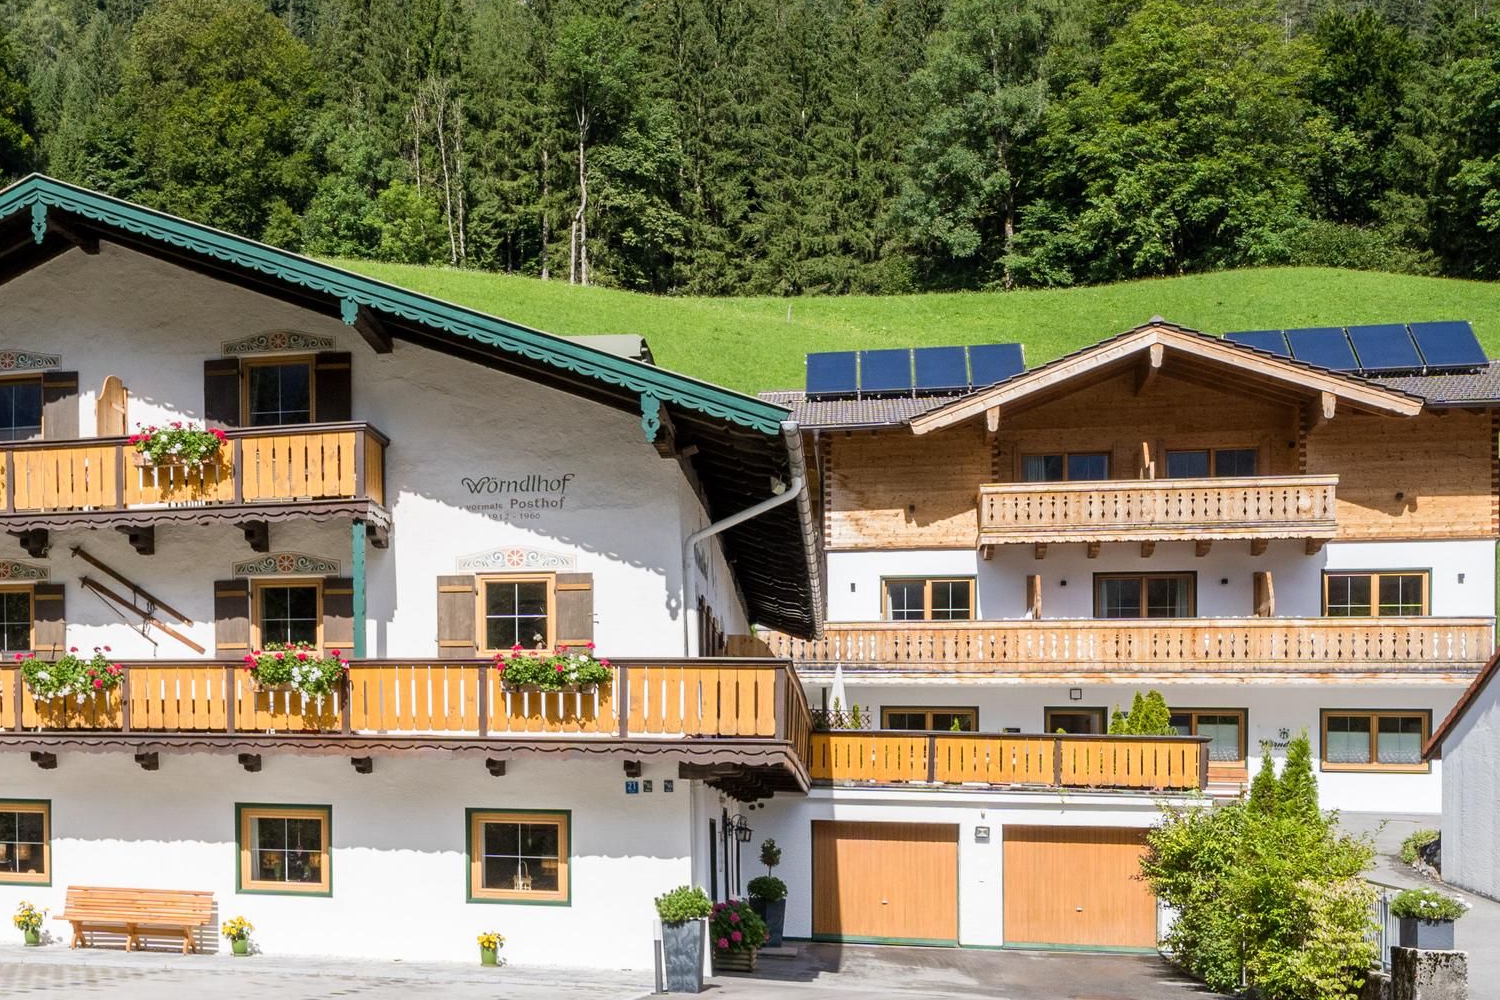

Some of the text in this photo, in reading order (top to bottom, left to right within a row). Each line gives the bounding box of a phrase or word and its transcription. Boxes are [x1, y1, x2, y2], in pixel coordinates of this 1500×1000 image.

[461, 473, 576, 494] Wörndlhof
[510, 497, 566, 510] Posthof
[627, 782, 637, 790] 21
